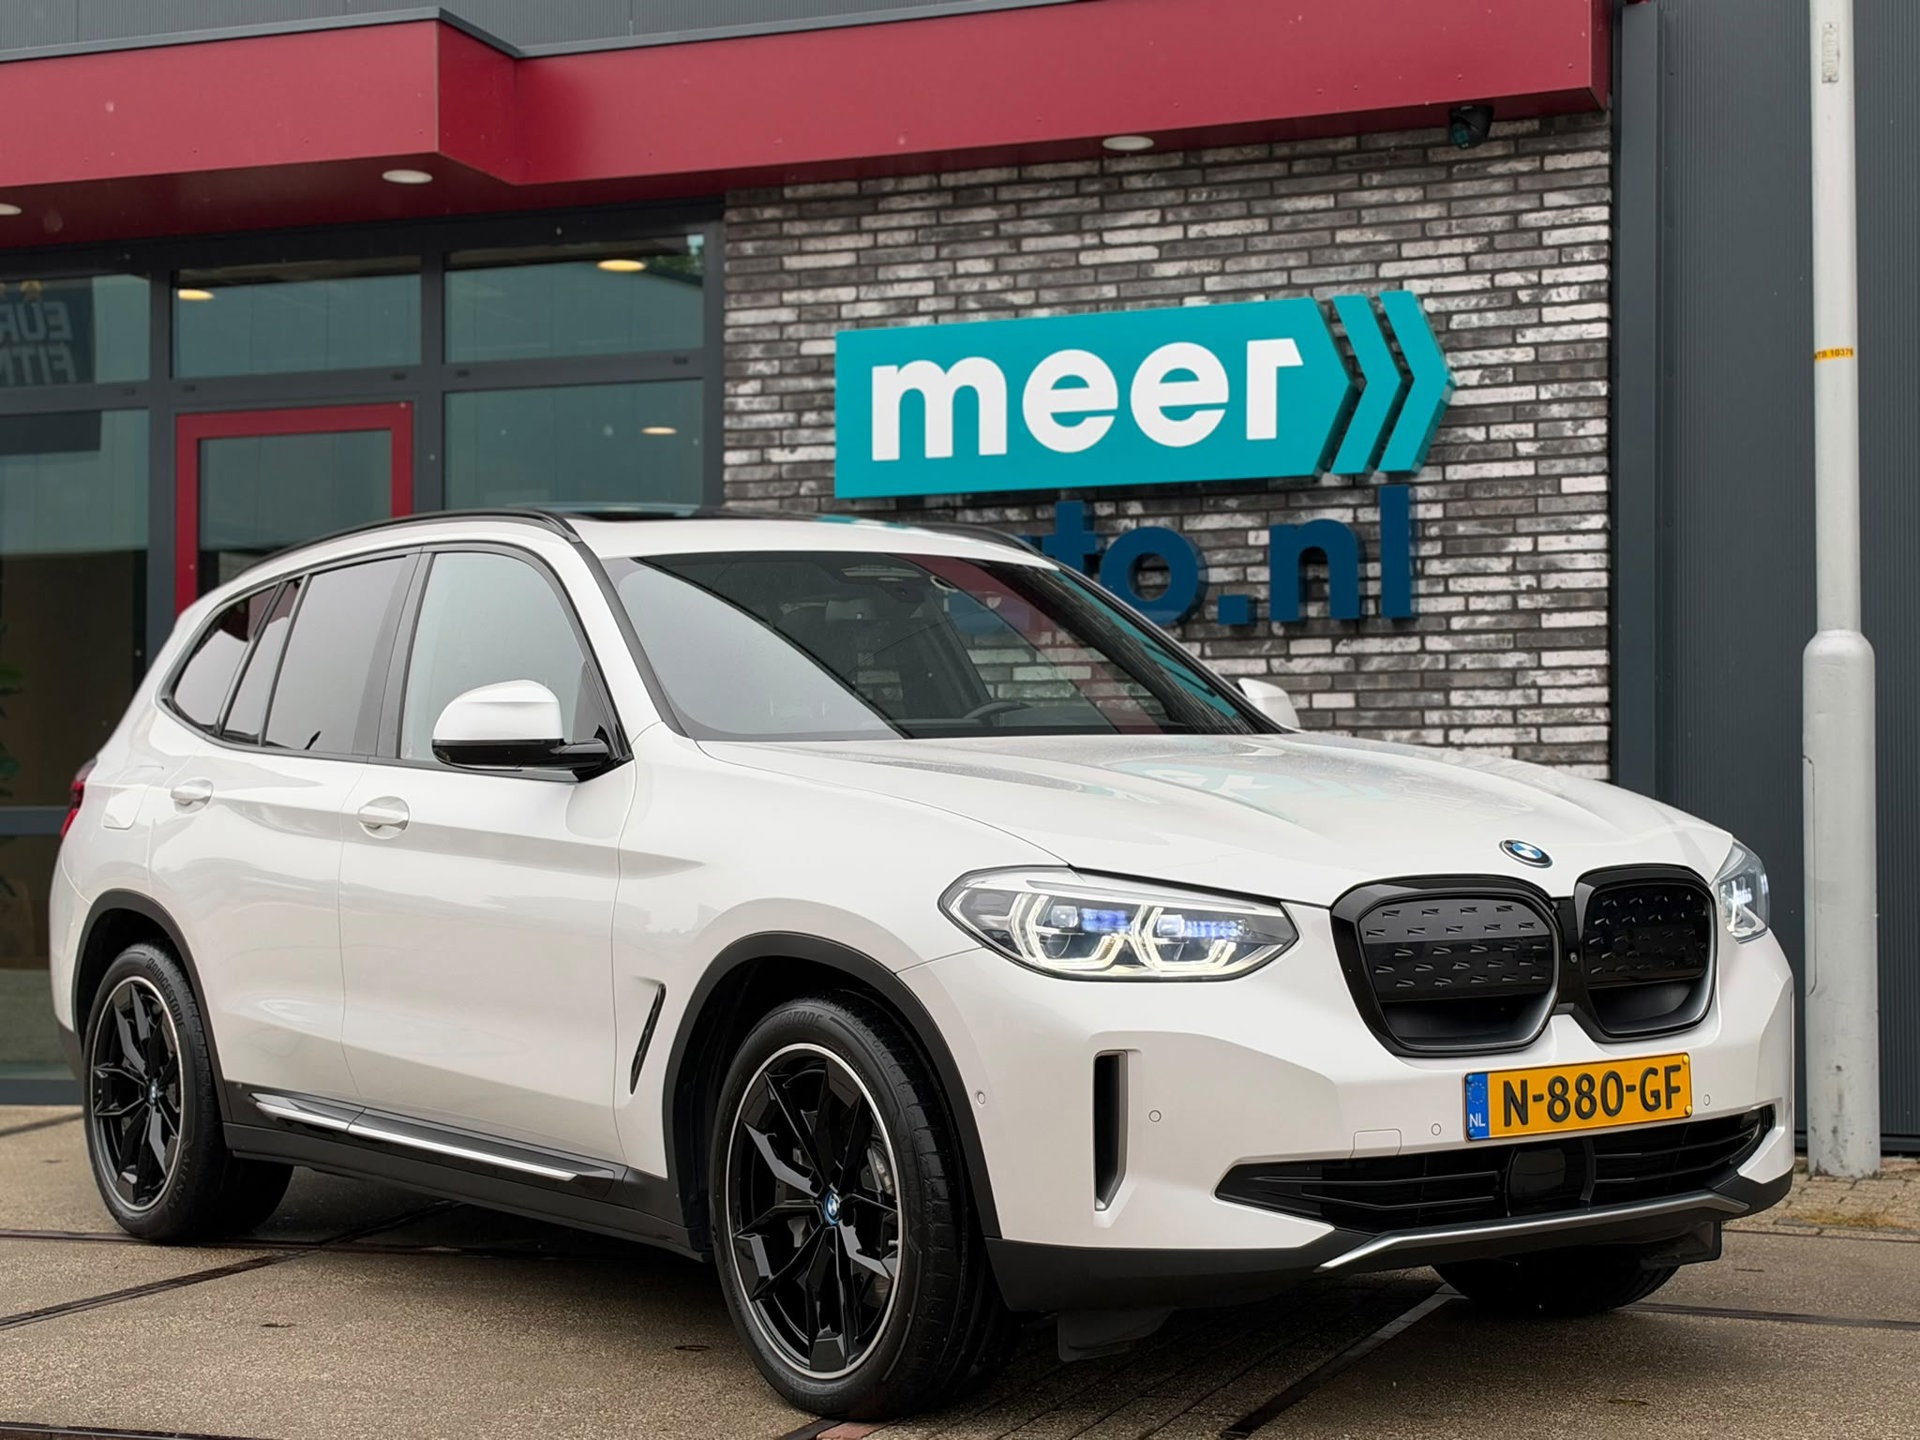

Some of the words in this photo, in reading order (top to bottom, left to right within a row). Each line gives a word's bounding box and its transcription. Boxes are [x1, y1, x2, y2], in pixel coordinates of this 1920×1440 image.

[871, 337, 1304, 461] meer
[1019, 484, 1417, 627] to.nl
[1469, 1112, 1486, 1127] NL
[1502, 1064, 1682, 1127] N-880-GF
